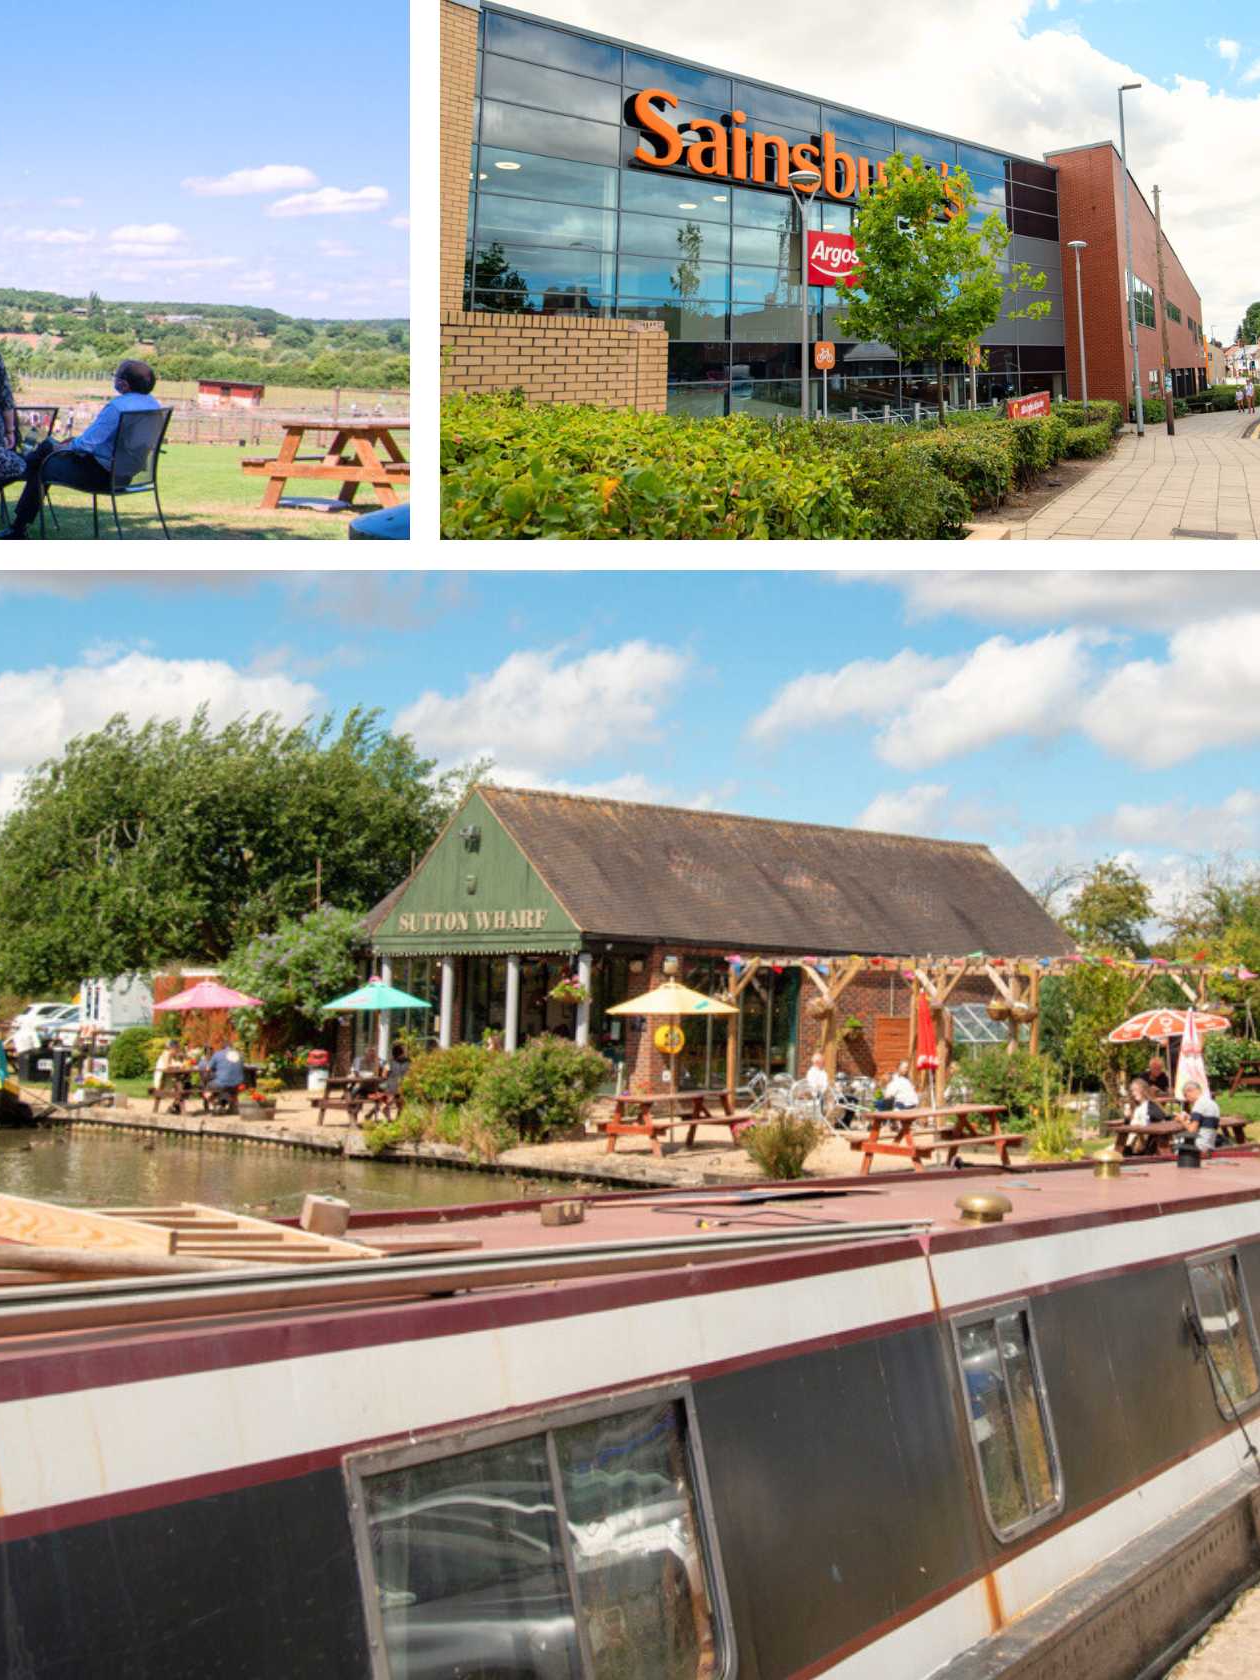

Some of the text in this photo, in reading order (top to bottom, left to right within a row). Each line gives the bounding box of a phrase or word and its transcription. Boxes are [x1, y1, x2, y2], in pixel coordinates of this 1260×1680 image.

[634, 88, 965, 220] Sainsbu's
[811, 240, 860, 268] Argos
[398, 909, 548, 933] SUTTON WHARF
